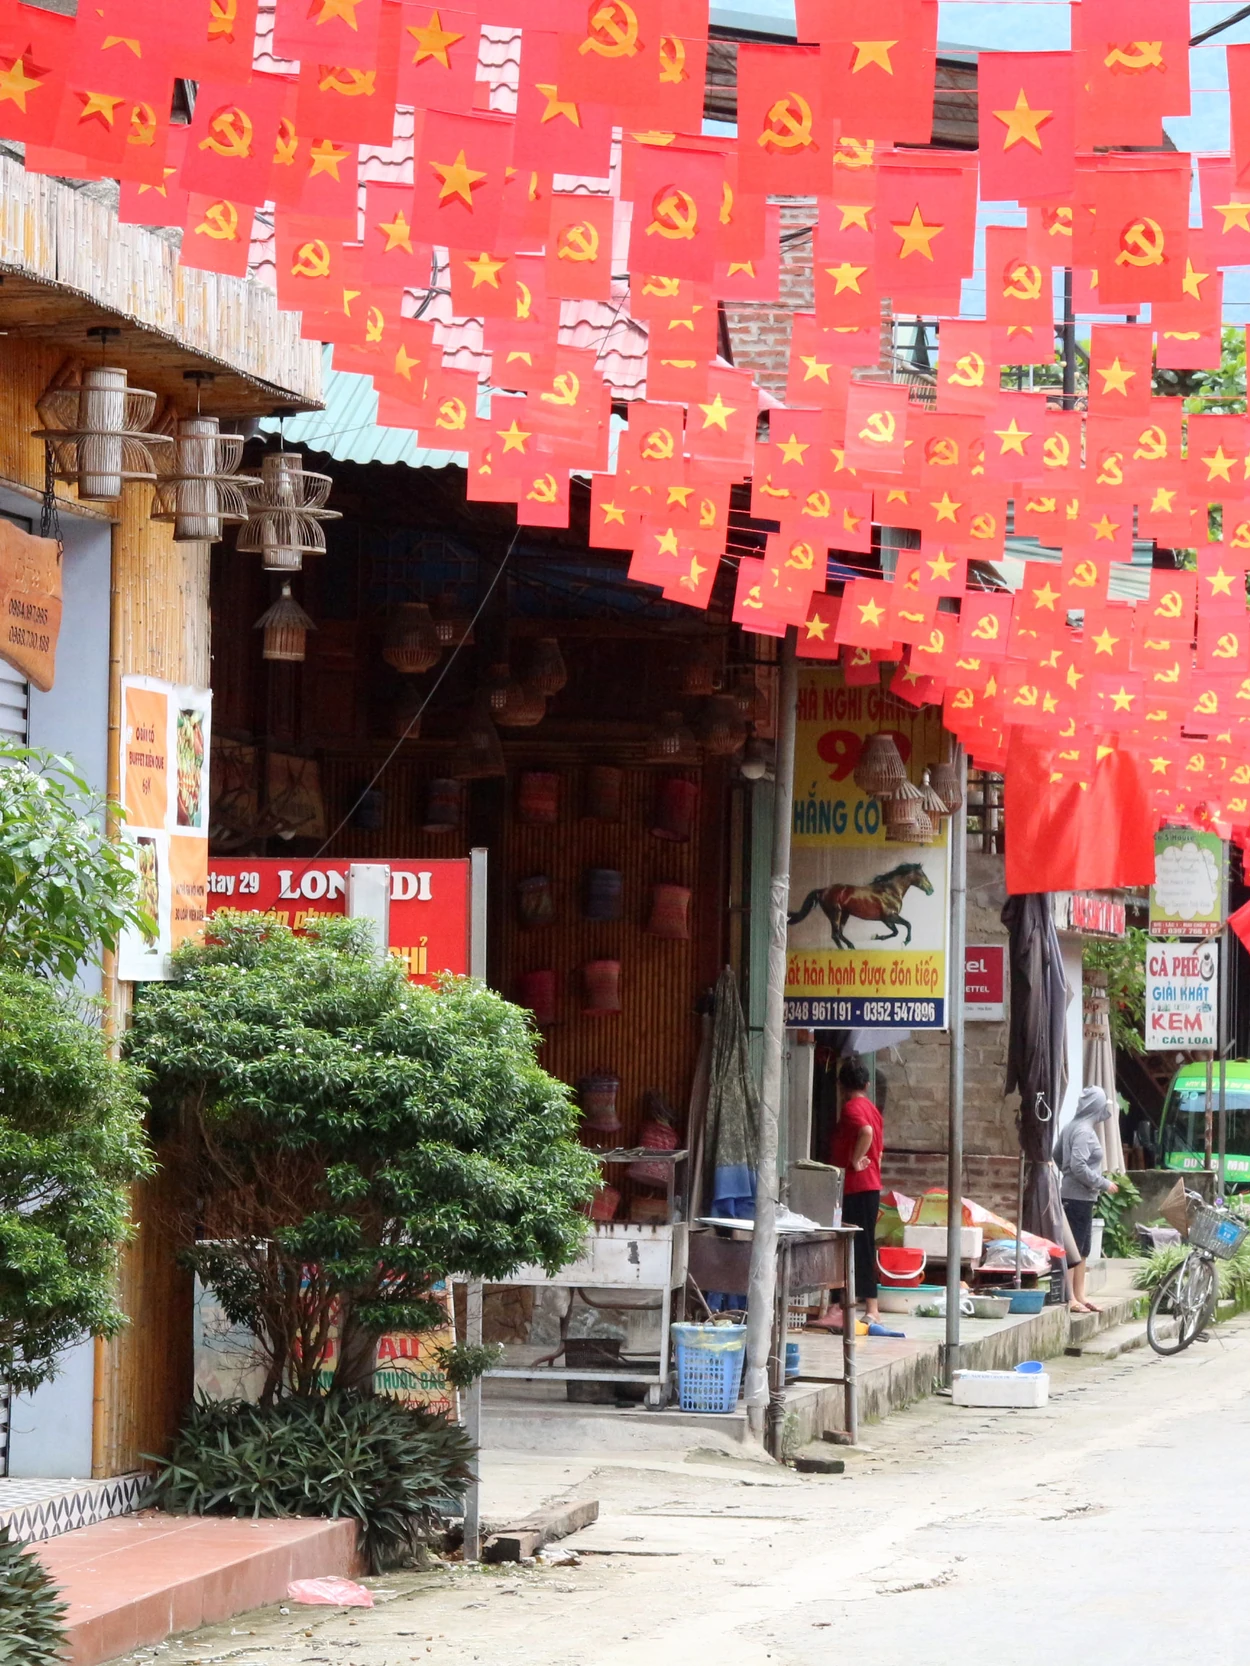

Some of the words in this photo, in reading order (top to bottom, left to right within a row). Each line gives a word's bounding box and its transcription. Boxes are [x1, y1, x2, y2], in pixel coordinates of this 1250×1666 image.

[239, 871, 260, 894] 29
[1149, 950, 1168, 977] CÀ
[1172, 951, 1200, 977] PHÊ
[787, 956, 799, 986] ất
[804, 959, 824, 986] hân
[829, 960, 855, 995] hạnh
[860, 959, 886, 993] được
[890, 960, 911, 986] đón
[915, 956, 939, 994] tiếp
[1152, 981, 1177, 1001] GIẢI
[1180, 982, 1209, 1001] KHÁT
[812, 1001, 852, 1021] 961191
[864, 1002, 891, 1021] 0352
[1151, 1012, 1203, 1032] KEM
[1162, 1034, 1185, 1045] CÁC
[1227, 1159, 1249, 1172] MAI
